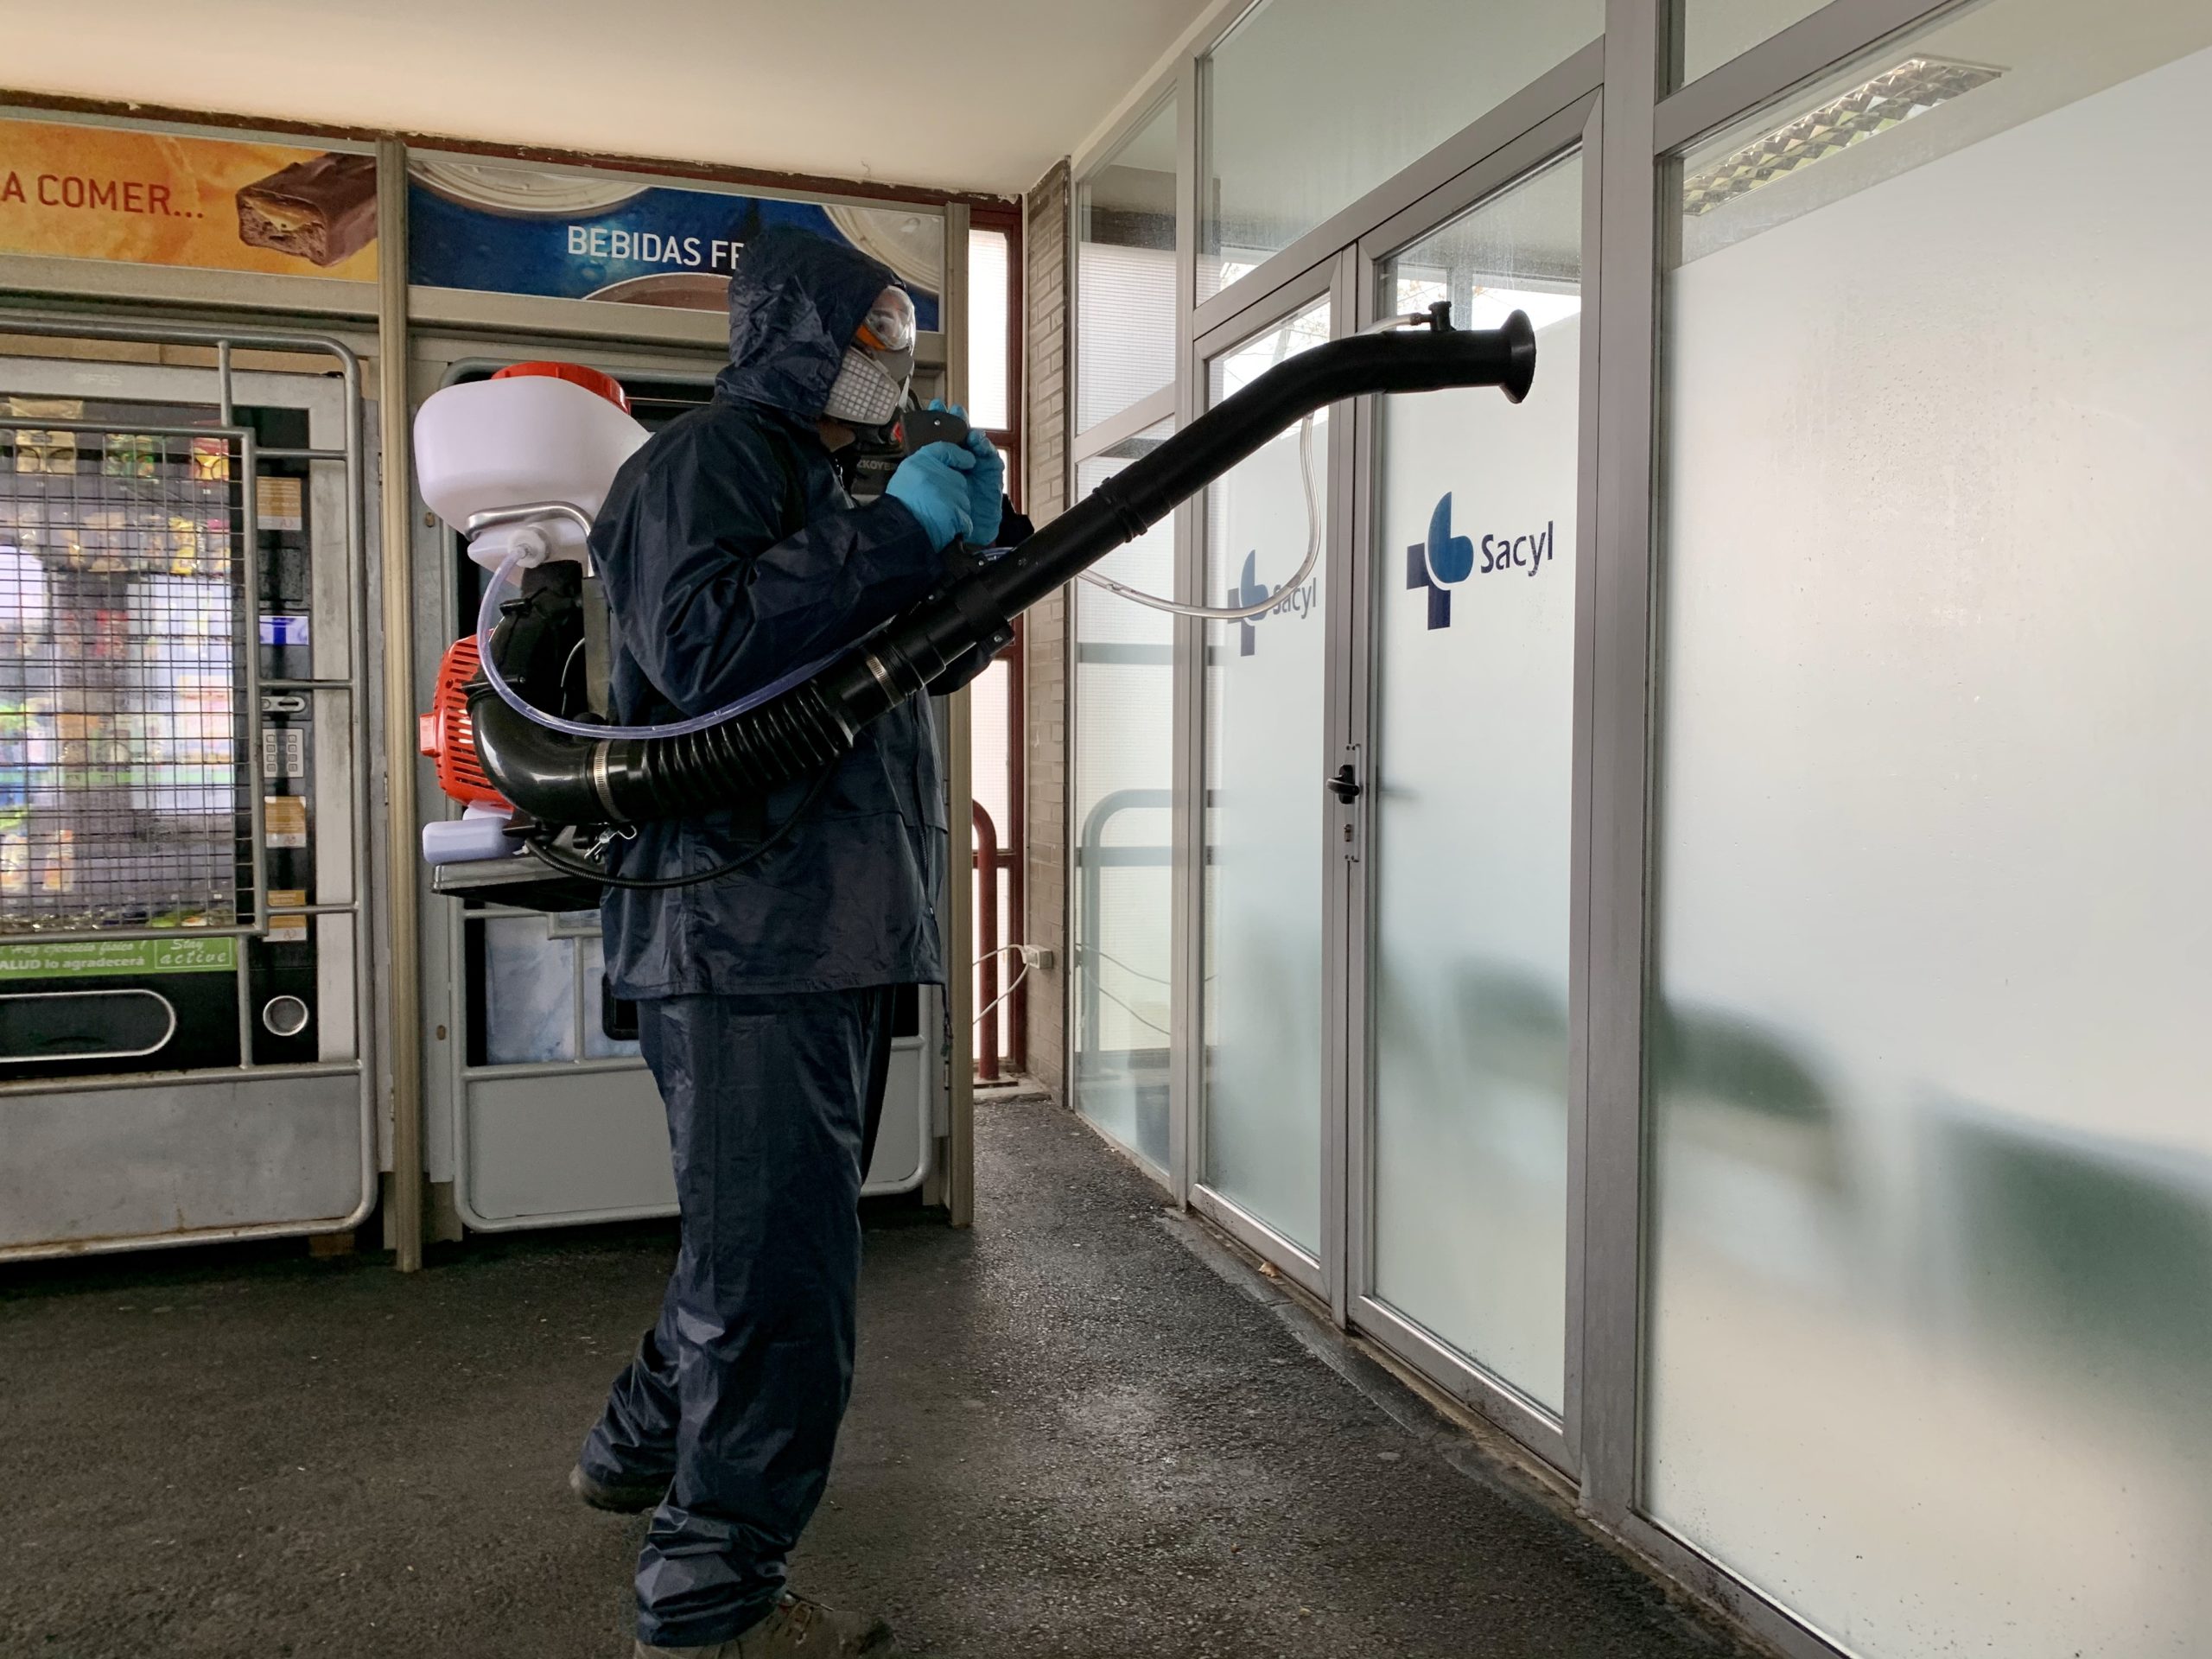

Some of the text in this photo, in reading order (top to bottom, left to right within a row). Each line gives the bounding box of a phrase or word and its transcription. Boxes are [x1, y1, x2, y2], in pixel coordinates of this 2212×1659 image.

[1, 170, 204, 219] A COMER...
[568, 225, 702, 267] BEBIDAS
[1480, 520, 1554, 577] Sacyl
[160, 950, 227, 964] active
[170, 938, 204, 950] Stay
[45, 959, 60, 969] lo
